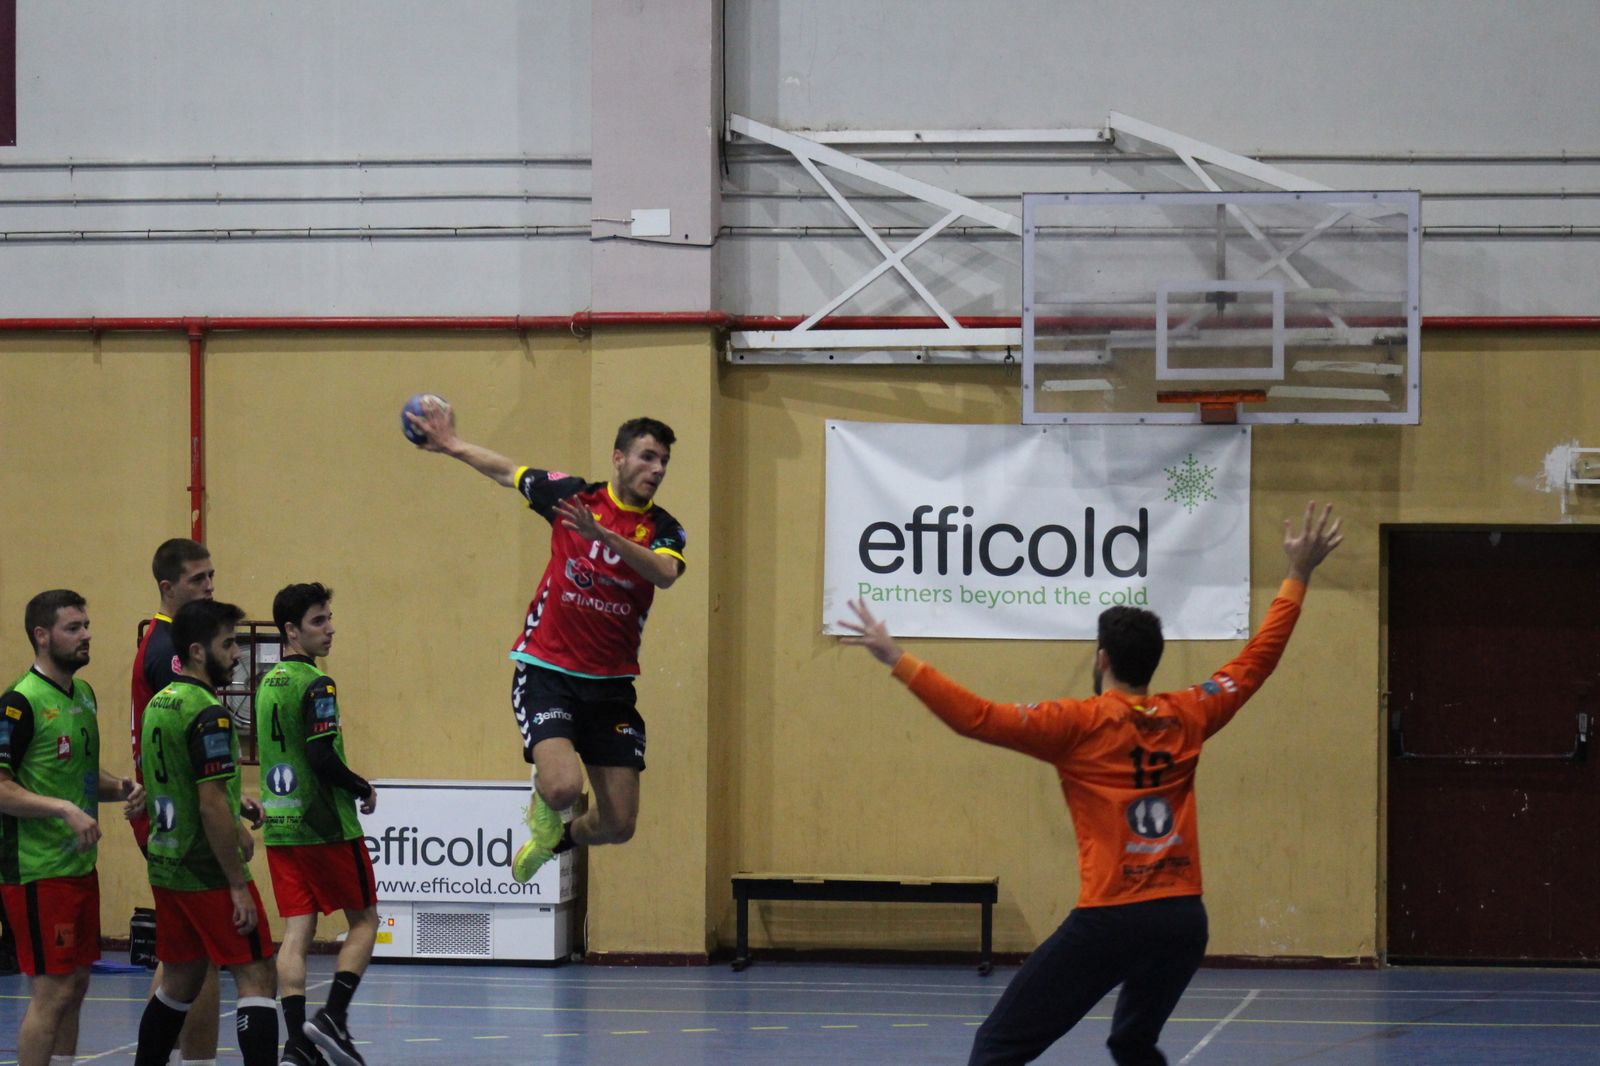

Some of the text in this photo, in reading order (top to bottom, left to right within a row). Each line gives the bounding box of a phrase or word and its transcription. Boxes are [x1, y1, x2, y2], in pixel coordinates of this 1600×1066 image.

[858, 505, 1148, 578] efficold
[858, 582, 1149, 608] Partners beyond the cold
[80, 727, 91, 756] 2
[271, 703, 286, 752] 4
[152, 726, 169, 784] 3
